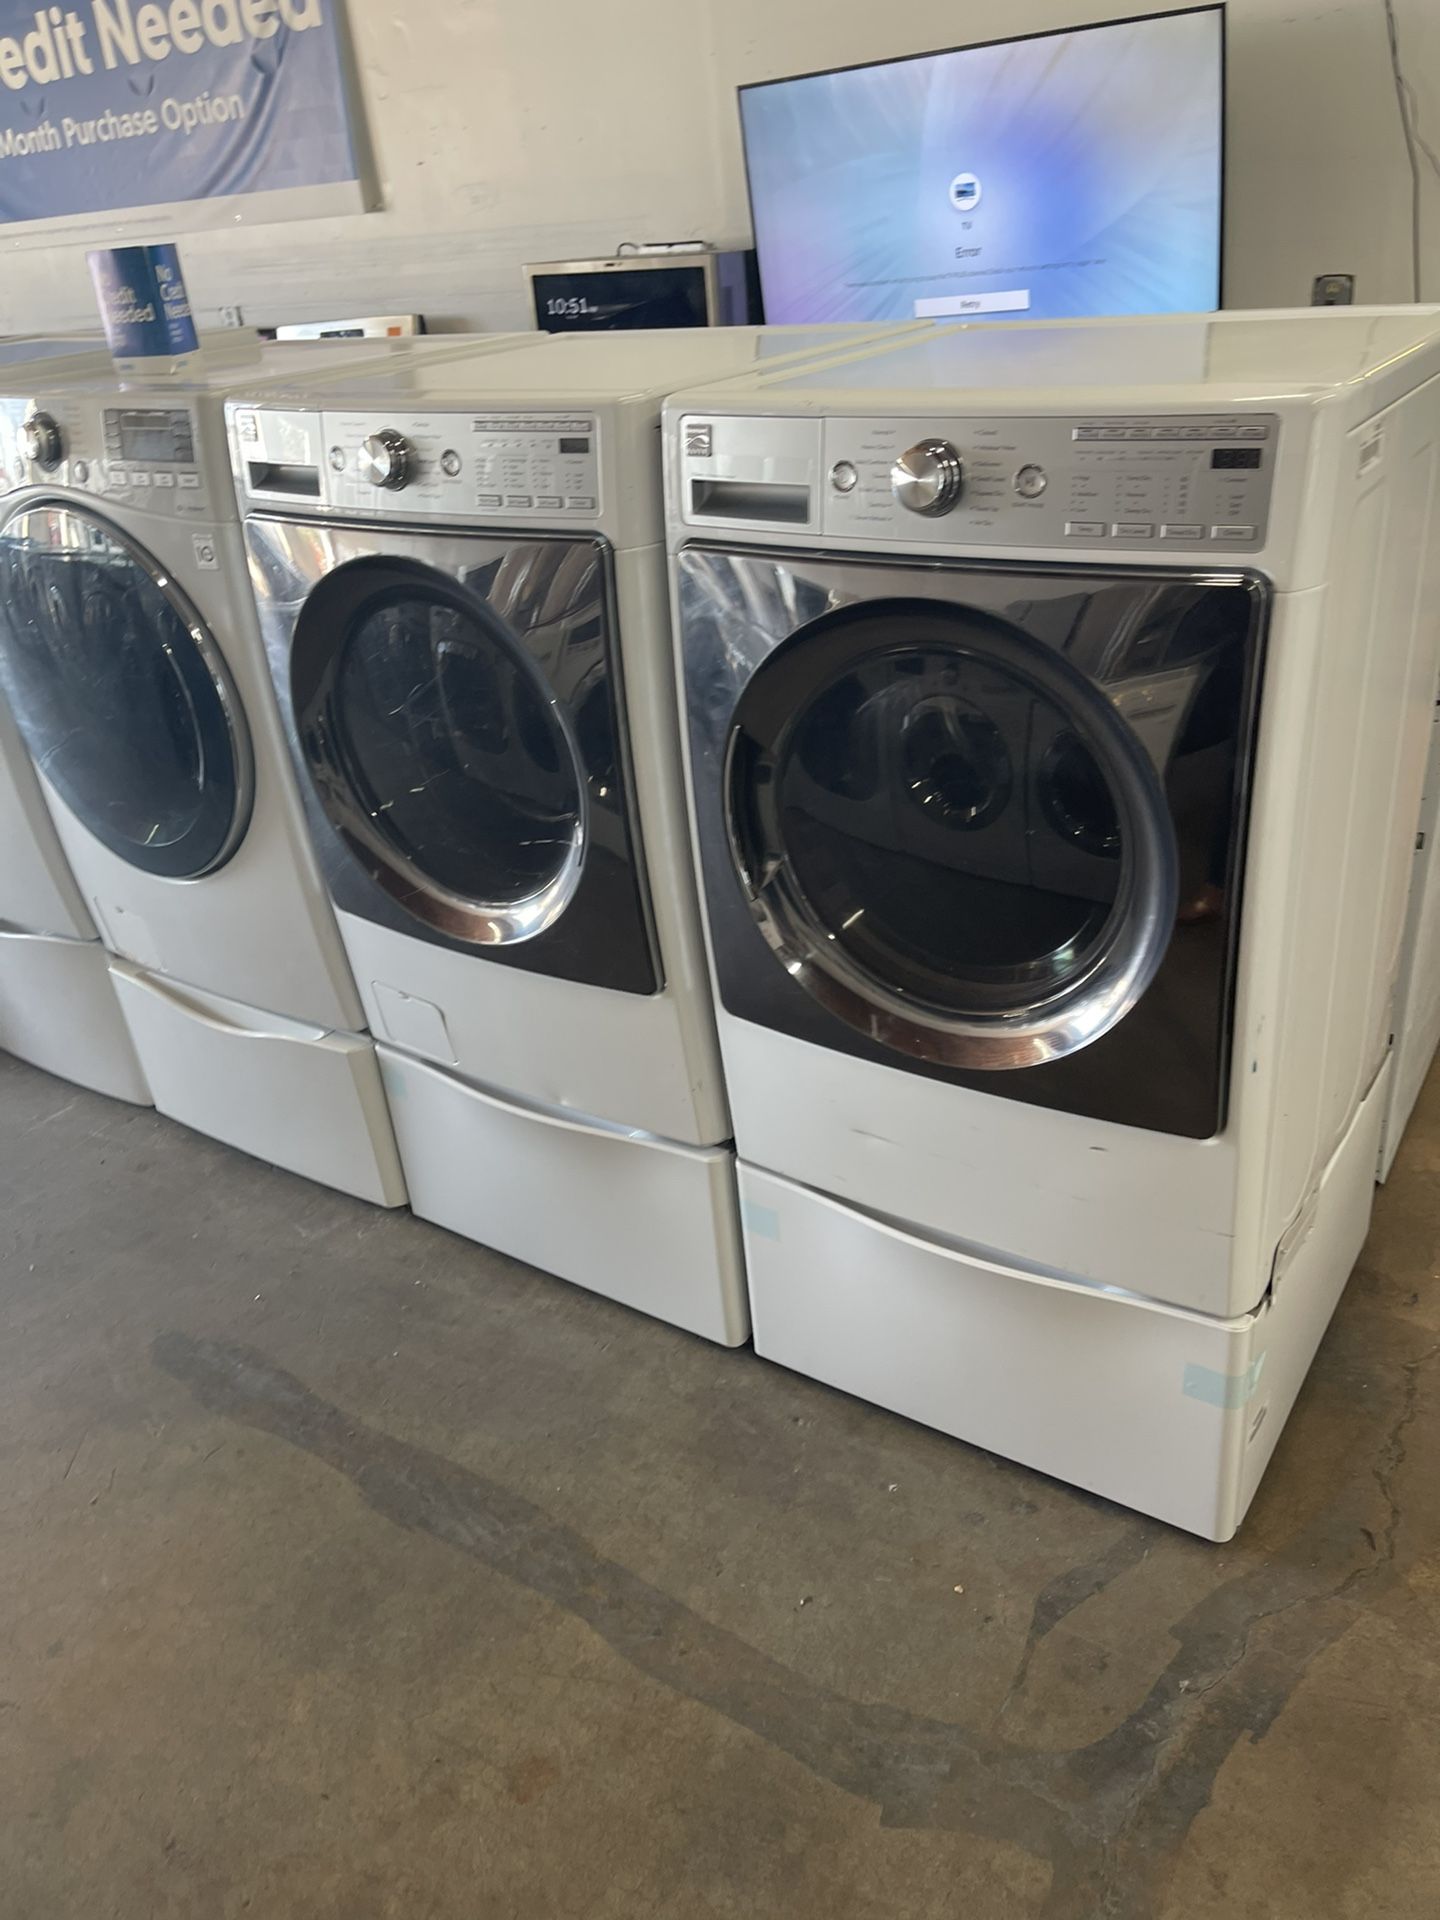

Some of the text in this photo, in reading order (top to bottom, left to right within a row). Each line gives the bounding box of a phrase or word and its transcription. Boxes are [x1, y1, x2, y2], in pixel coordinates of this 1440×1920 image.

[91, 0, 323, 69] Needed
[0, 92, 244, 159] Month Purchase Option
[955, 246, 982, 259] Error
[547, 297, 587, 314] 10:51
